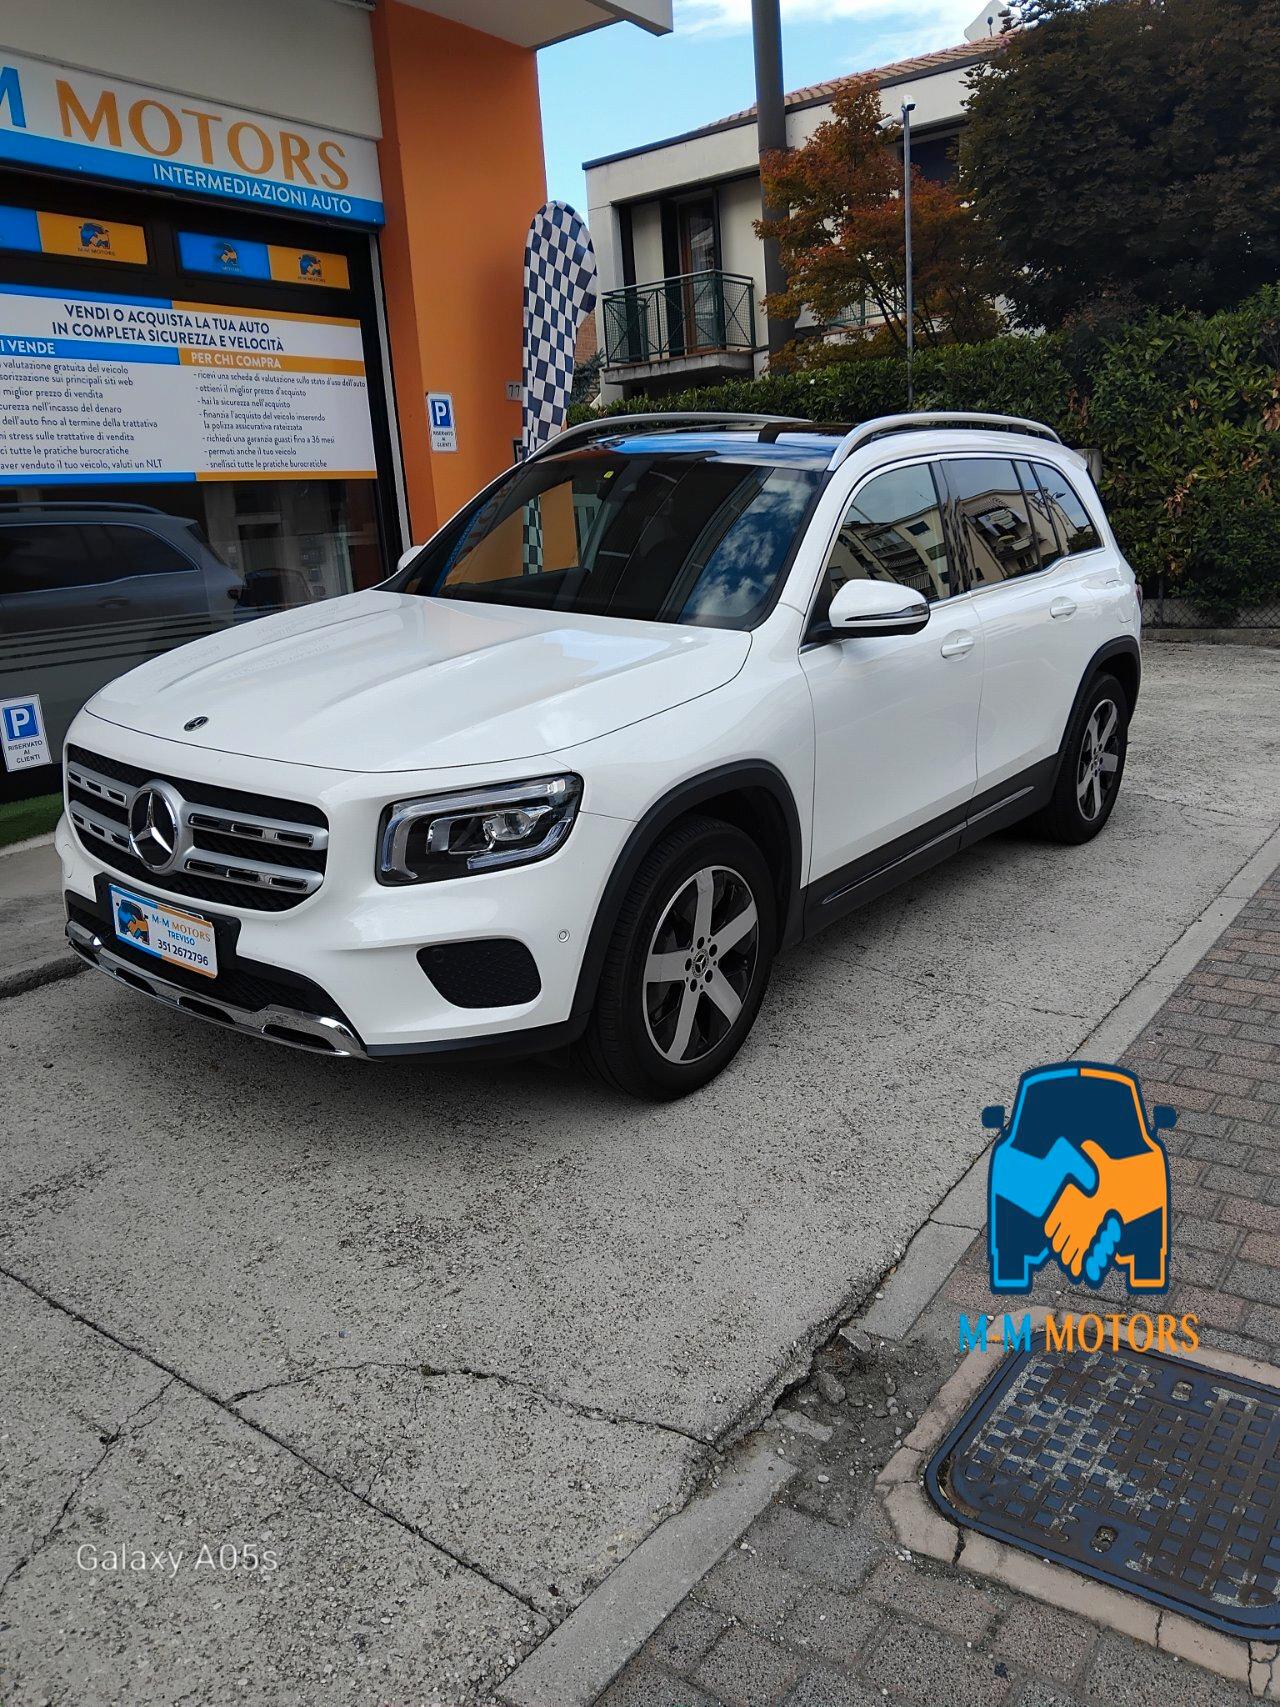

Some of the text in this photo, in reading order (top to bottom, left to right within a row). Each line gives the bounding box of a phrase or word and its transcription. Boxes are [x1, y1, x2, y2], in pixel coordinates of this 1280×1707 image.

[56, 79, 349, 190] MOTORS
[152, 163, 351, 214] INTERMEDIAZIONI AUTO
[64, 304, 270, 334] VENDI O ACQUISTA LA TUA AUTO
[52, 322, 284, 351] IN COMPLETA SICUREZZA E VELOCITÀ
[7, 339, 56, 355] VENDE
[3, 359, 129, 374] valutazione gratuita del veicolo
[191, 352, 282, 369] PER CHI COMPRA
[52, 373, 64, 383] sui
[66, 375, 103, 388] principali
[105, 376, 116, 385] siti
[118, 377, 134, 386] web
[198, 370, 216, 379] ricevi
[217, 372, 230, 380] una
[231, 372, 253, 381] scheda
[254, 373, 260, 382] di
[261, 374, 295, 383] valutazione
[3, 387, 104, 400] miglior prezzo di vendita
[200, 383, 223, 393] ottieni
[224, 384, 229, 393] il
[229, 385, 253, 397] miglior
[253, 388, 274, 397] prezzo
[32, 401, 79, 412] nell'incasso
[81, 403, 93, 413] del
[95, 403, 122, 413] denaro
[201, 396, 212, 405] hai
[213, 397, 220, 405] la
[220, 397, 250, 407] sicurezza
[262, 411, 273, 420] del
[273, 412, 296, 421] veicolo
[296, 413, 326, 422] inserendo
[434, 401, 447, 425] P
[2, 415, 158, 428] dell'auto fino al termine della trattativa
[203, 420, 210, 429] la
[235, 421, 273, 430] assicurativa
[9, 432, 34, 440] stress
[35, 430, 55, 441] sulle
[56, 431, 95, 441] trattative
[97, 431, 104, 441] di
[106, 431, 135, 441] vendita
[247, 435, 273, 446] garanzia
[274, 435, 293, 446] guasti
[294, 434, 306, 444] fino
[311, 435, 320, 444] 36
[9, 446, 32, 455] tutte
[33, 445, 42, 455] le
[43, 445, 78, 458] pratiche
[79, 445, 129, 455] burocratiche
[208, 447, 297, 458] permuti anche il tuo veicolo
[0, 458, 163, 470] aver venduto il tuo veicolo, valuti un NLT
[237, 460, 254, 468] tutte
[255, 459, 262, 468] le
[263, 459, 289, 470] pratiche
[289, 459, 328, 469] burocratiche
[10, 708, 30, 737] P
[7, 740, 43, 751] RISERVATO
[16, 754, 41, 764] CLIENTI
[151, 914, 211, 943] M-M MOTORS
[167, 929, 196, 946] TREVISO
[157, 939, 209, 966] 351 2672796
